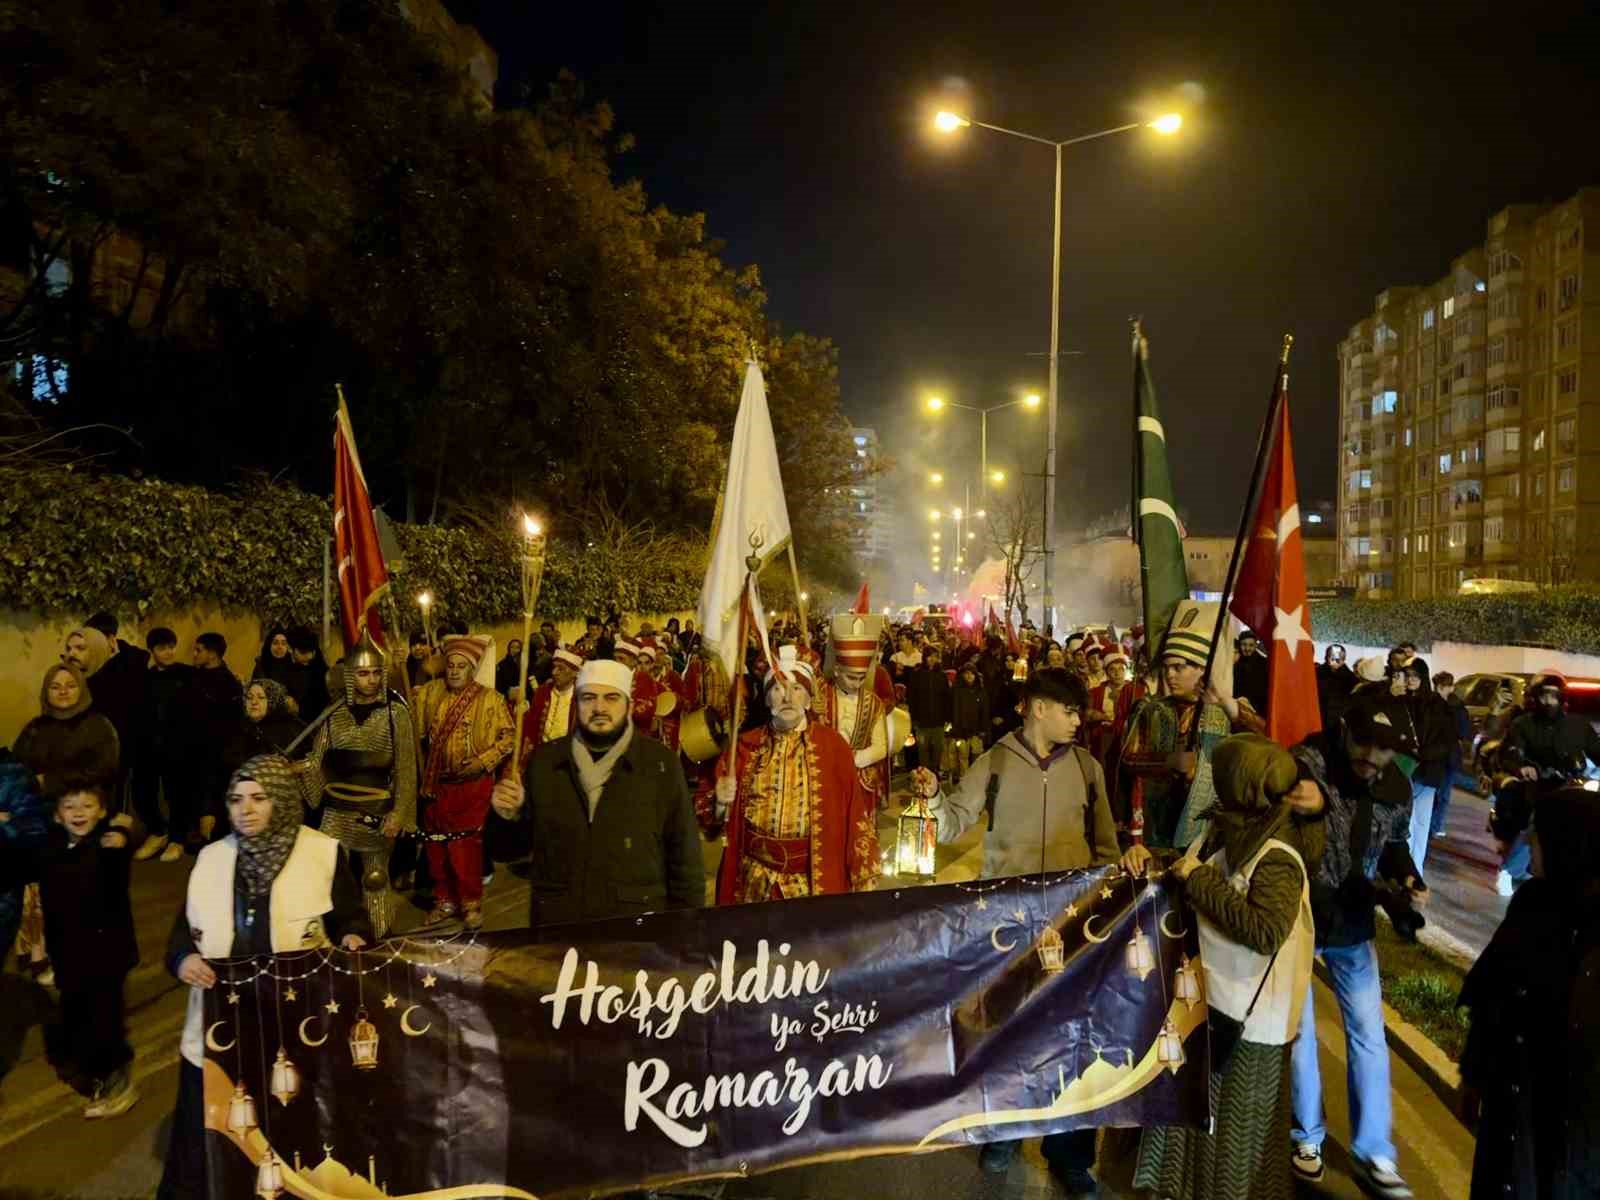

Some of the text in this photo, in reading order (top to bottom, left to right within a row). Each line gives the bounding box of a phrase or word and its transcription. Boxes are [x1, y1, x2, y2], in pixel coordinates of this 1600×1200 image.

[540, 939, 830, 1040] Hoşgeldin
[770, 1001, 881, 1052] Ya Şehri
[624, 1054, 893, 1148] Ramazan
